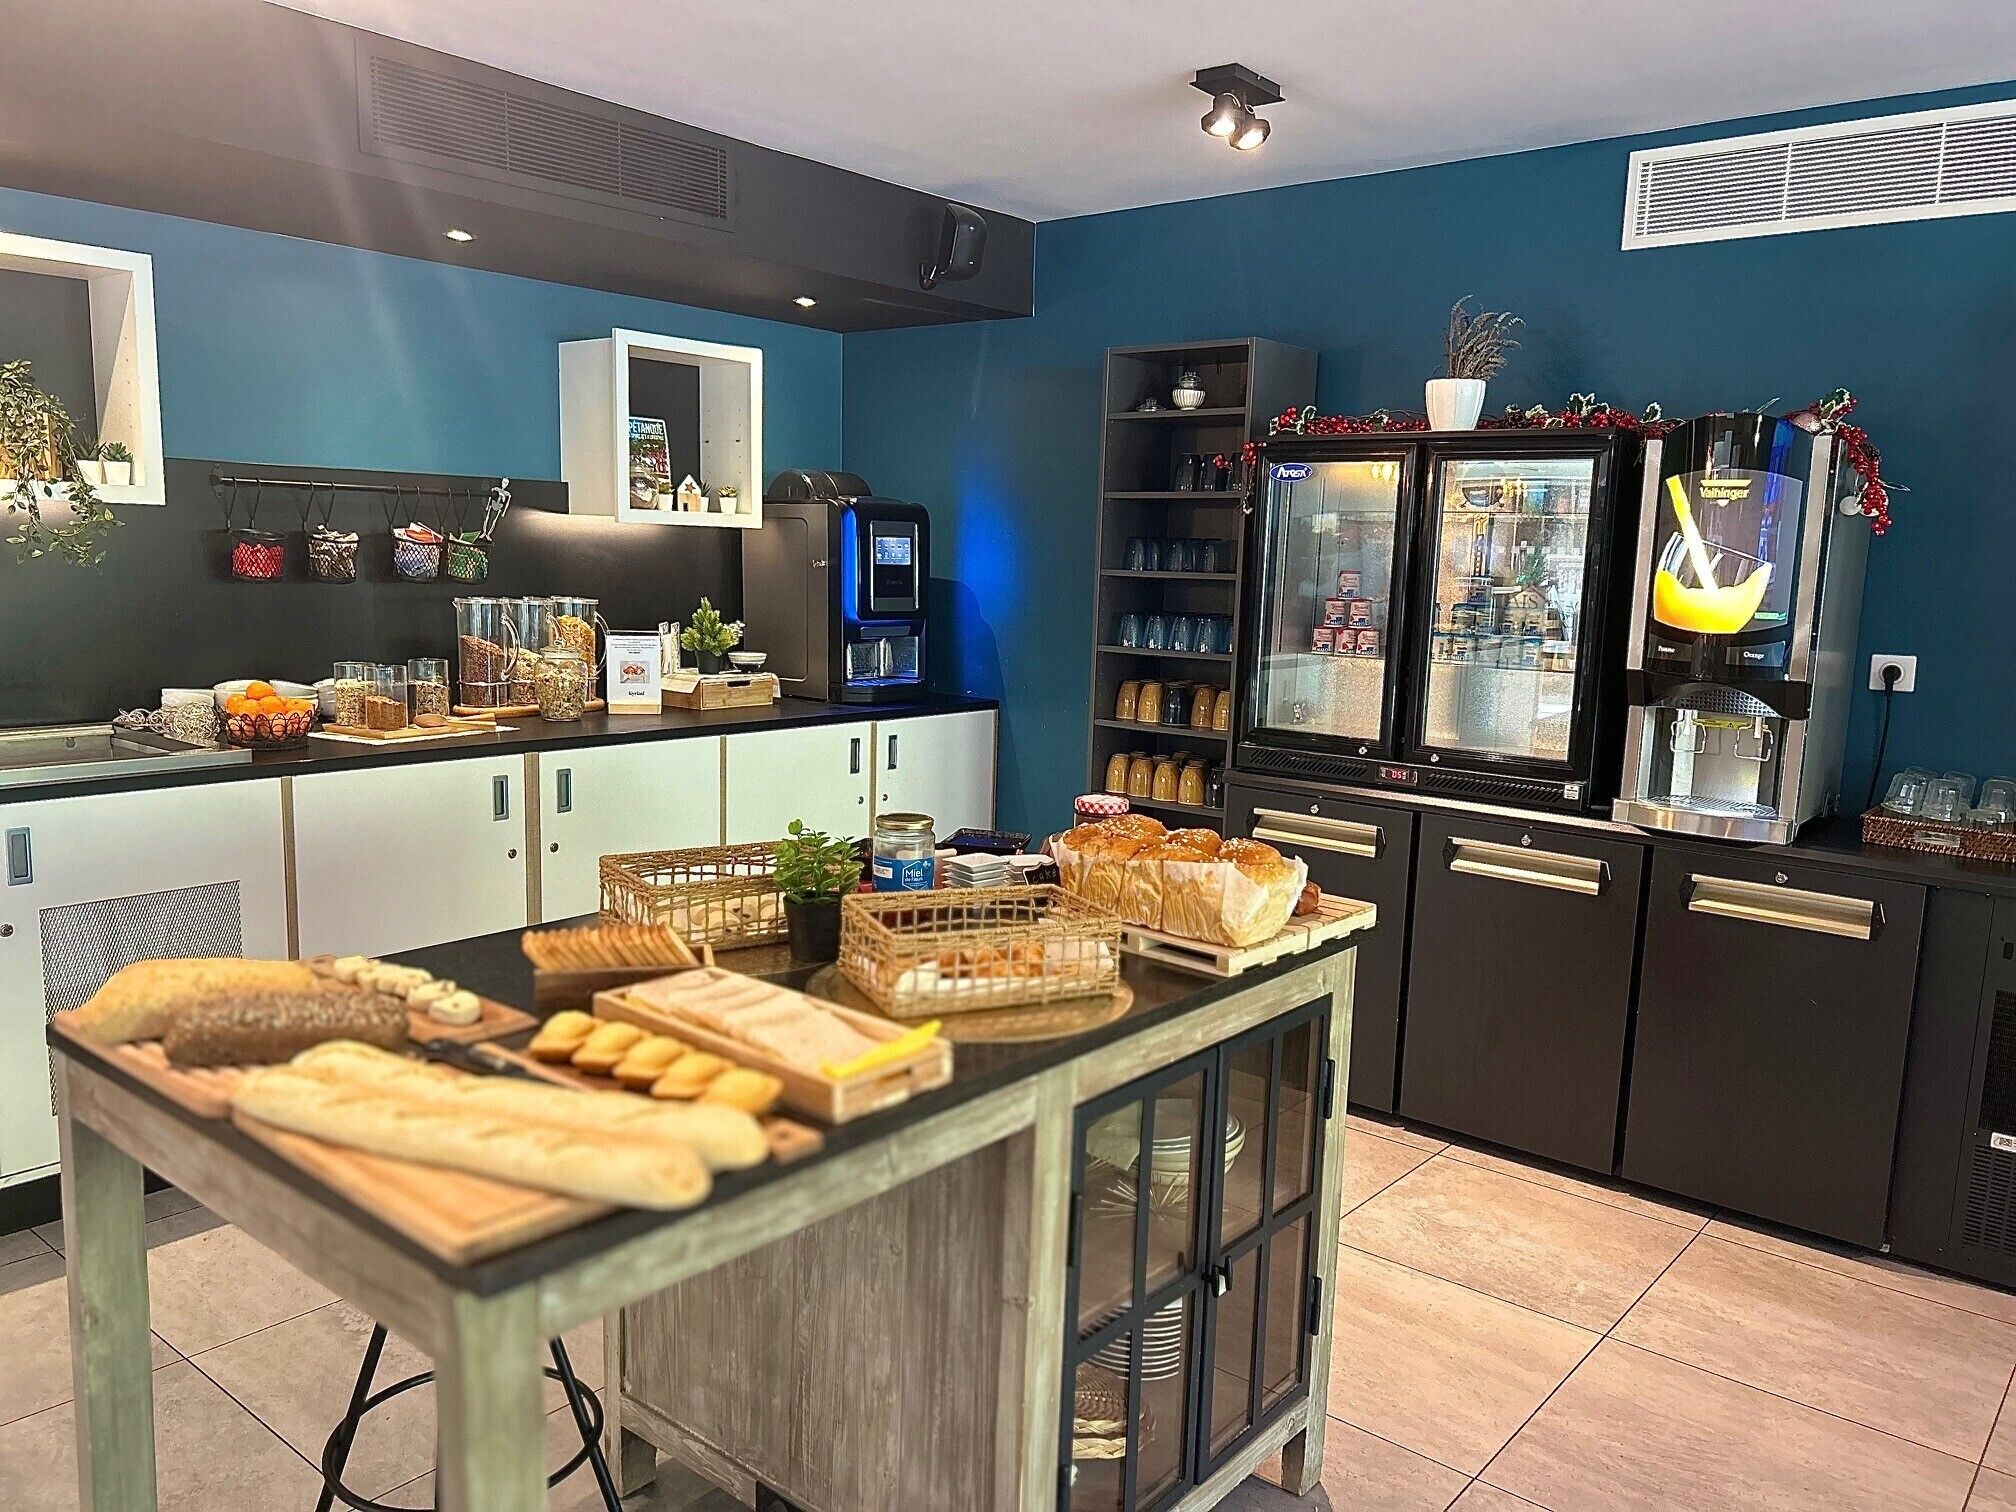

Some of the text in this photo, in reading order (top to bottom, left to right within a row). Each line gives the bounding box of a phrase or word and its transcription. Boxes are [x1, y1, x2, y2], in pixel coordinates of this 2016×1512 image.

[1700, 486, 1750, 501] Vaihinger
[1743, 651, 1765, 660] Orange
[905, 868, 923, 878] Miel
